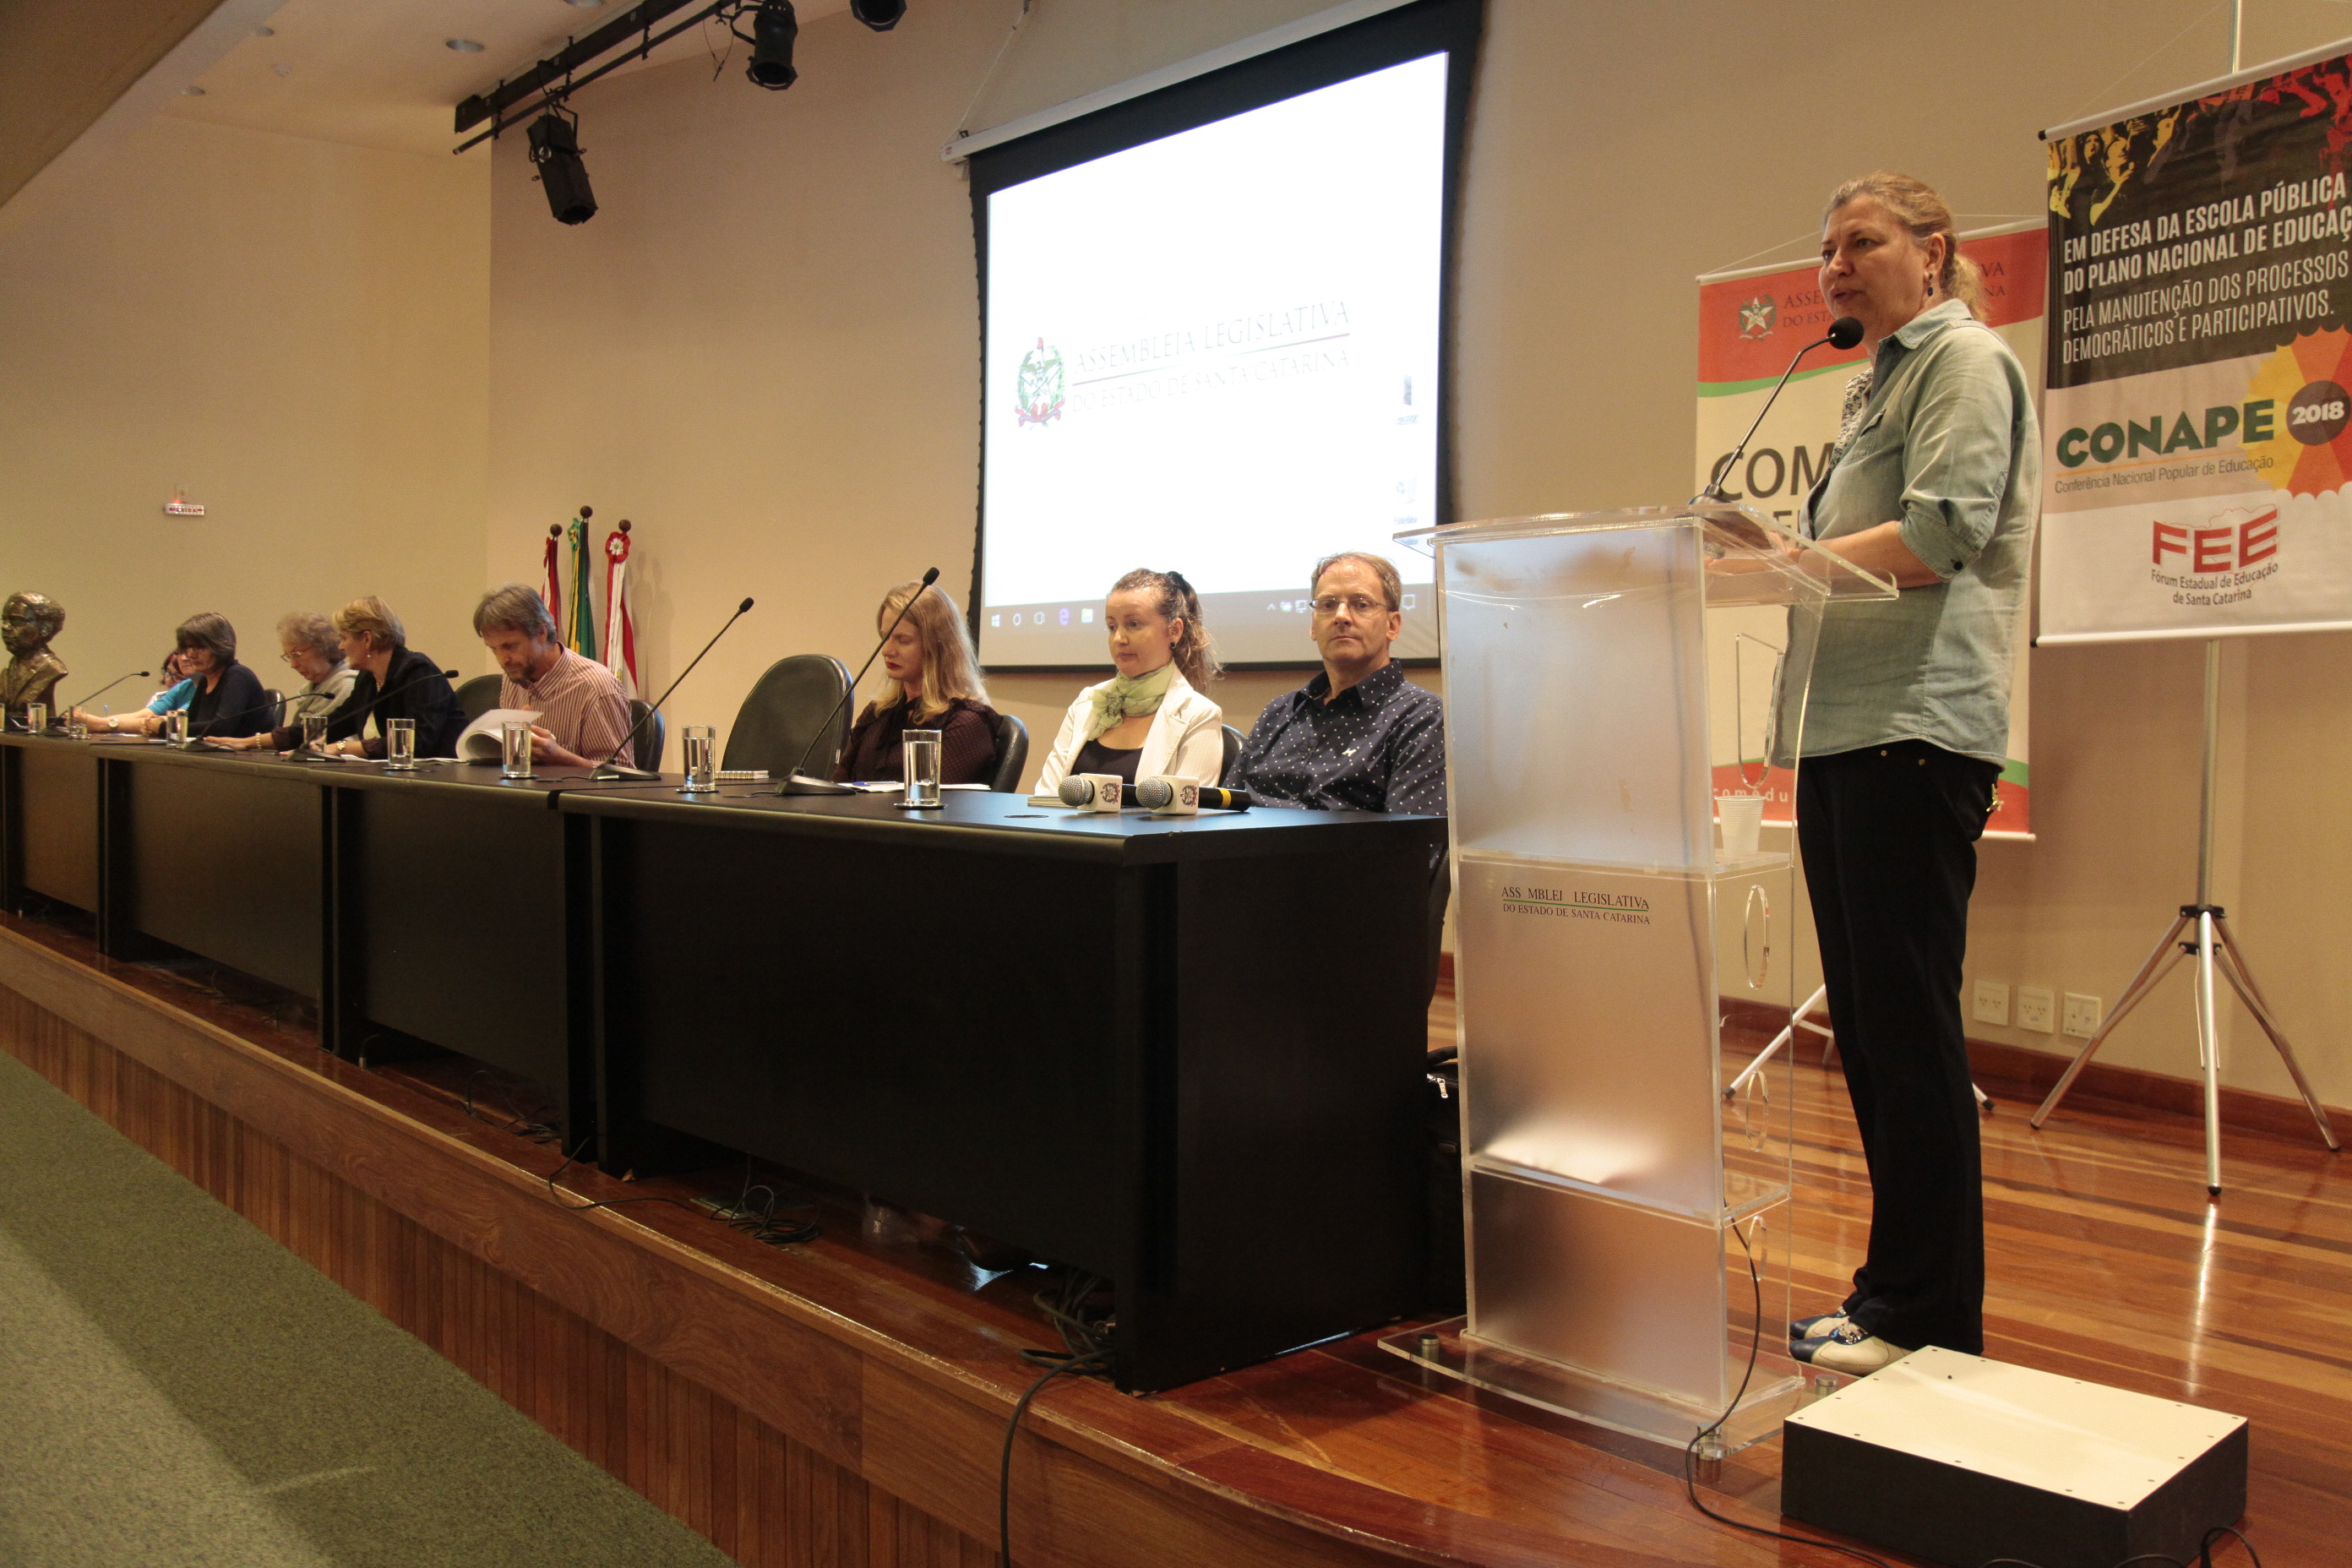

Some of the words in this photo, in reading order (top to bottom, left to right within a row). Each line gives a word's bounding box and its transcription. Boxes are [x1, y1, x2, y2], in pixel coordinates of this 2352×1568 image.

[2064, 236, 2087, 264] EM
[2091, 220, 2153, 258] DEFESA
[2157, 213, 2180, 242] DA
[2185, 195, 2255, 235] ESCOLA
[2261, 172, 2347, 217] PÚBLICA
[2063, 303, 2094, 334] PELA
[2099, 280, 2203, 326] MANUTENÇÃO
[2208, 273, 2240, 304] DOS
[2246, 250, 2349, 297] PROCESSOS
[2064, 268, 2084, 295] DO
[2088, 254, 2142, 289] PLANO
[2147, 232, 2239, 276] NACIONAL
[2244, 225, 2268, 255] DE
[1075, 331, 1195, 374] ASSEMBLEIA
[1205, 300, 1349, 349] LEGISLATIVA
[2063, 318, 2175, 364] DEMOCRÁTICOS
[2179, 318, 2186, 341] E
[2191, 289, 2334, 340] PARTICIPATIVOS.
[1073, 392, 1096, 412] DO
[1102, 380, 1161, 408] ESTADO
[1168, 375, 1187, 396] DE
[1255, 350, 1349, 381] CATARINA
[2291, 401, 2345, 425] 2018
[2056, 399, 2275, 468] CONAPE
[2055, 475, 2110, 493] Conferência
[2113, 469, 2156, 487] Nacional
[2159, 464, 2199, 482] Popular
[2202, 461, 2215, 475] de
[2219, 456, 2274, 476] Educação
[2152, 508, 2278, 574] FEE
[2151, 569, 2178, 588] Fórum
[2180, 576, 2219, 591] Estadual
[2219, 574, 2232, 589] de
[2234, 562, 2278, 585] Educação
[2172, 591, 2185, 604] de
[2185, 592, 2211, 606] Santa
[2213, 588, 2252, 606] Catarina
[1503, 903, 1516, 912] DO
[1518, 905, 1554, 916] ESTADO
[1556, 907, 1569, 917] DE
[1571, 909, 1601, 920] SANTA
[1603, 912, 1651, 925] CATARINA
[1574, 891, 1650, 910] LEGISLATIVA
